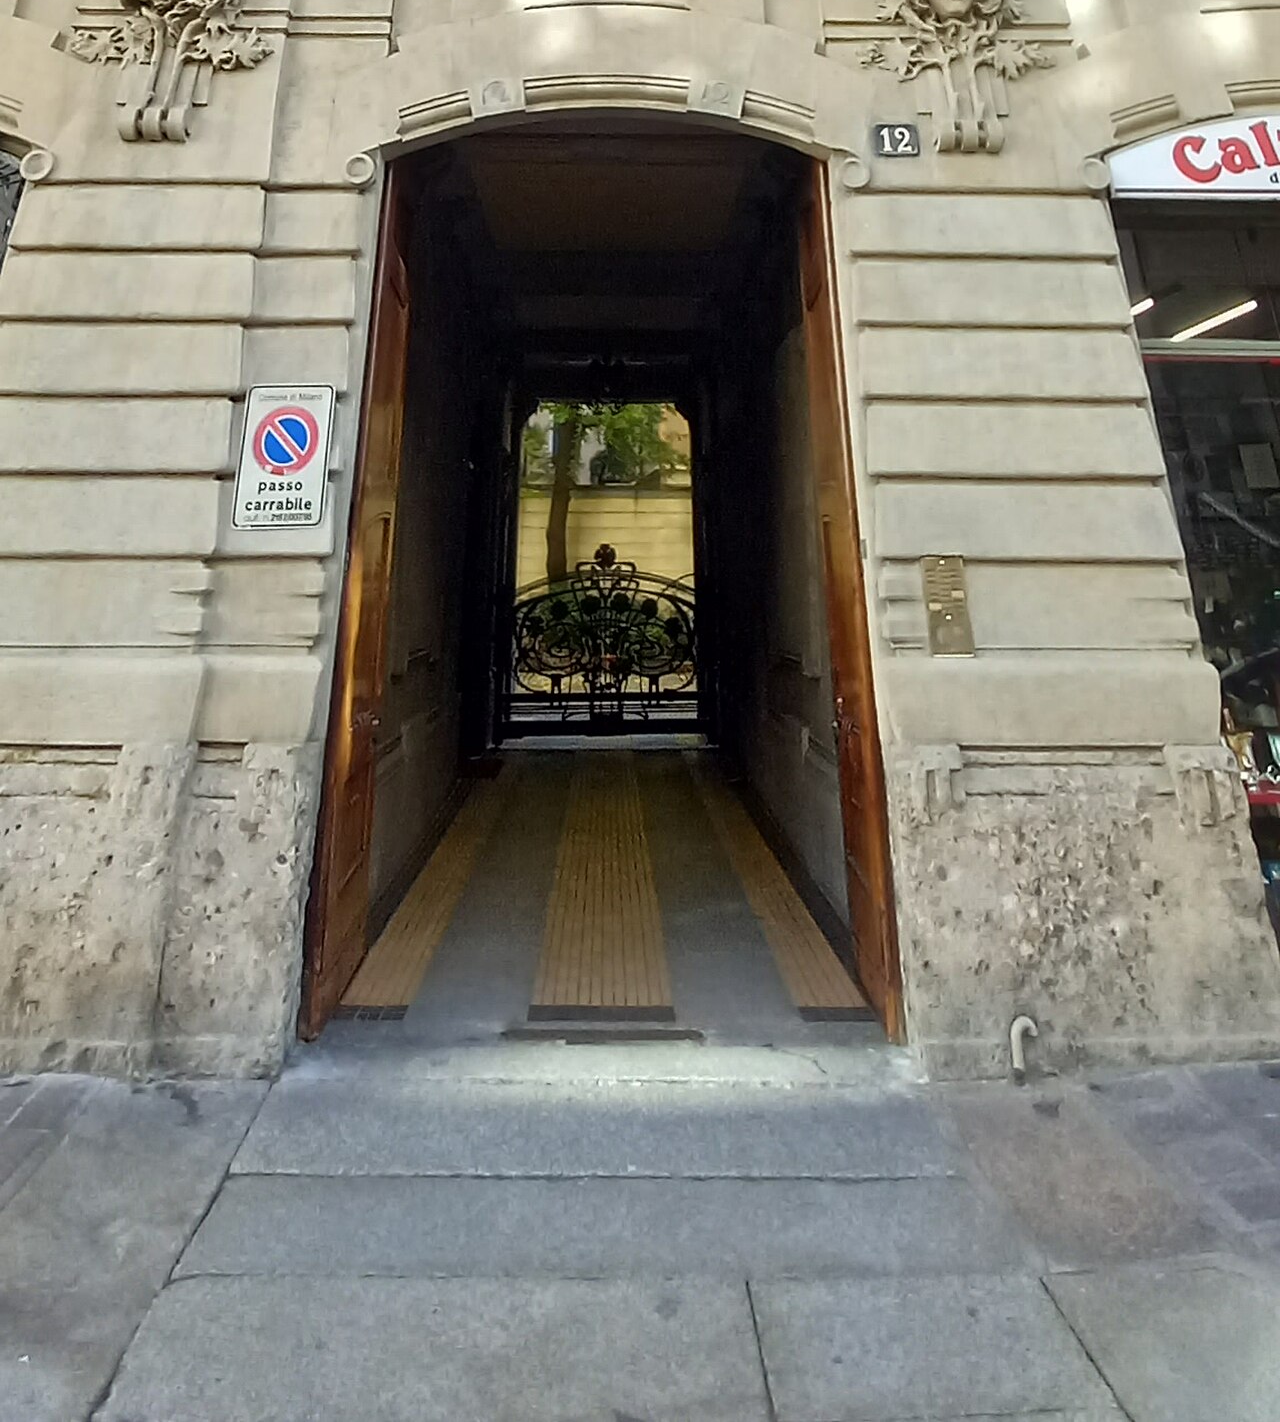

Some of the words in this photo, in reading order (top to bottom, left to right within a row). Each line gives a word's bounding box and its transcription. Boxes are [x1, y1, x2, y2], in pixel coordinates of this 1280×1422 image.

[879, 126, 913, 153] 12
[1172, 119, 1280, 184] Cal
[257, 481, 303, 495] passo
[245, 497, 312, 511] carrabile
